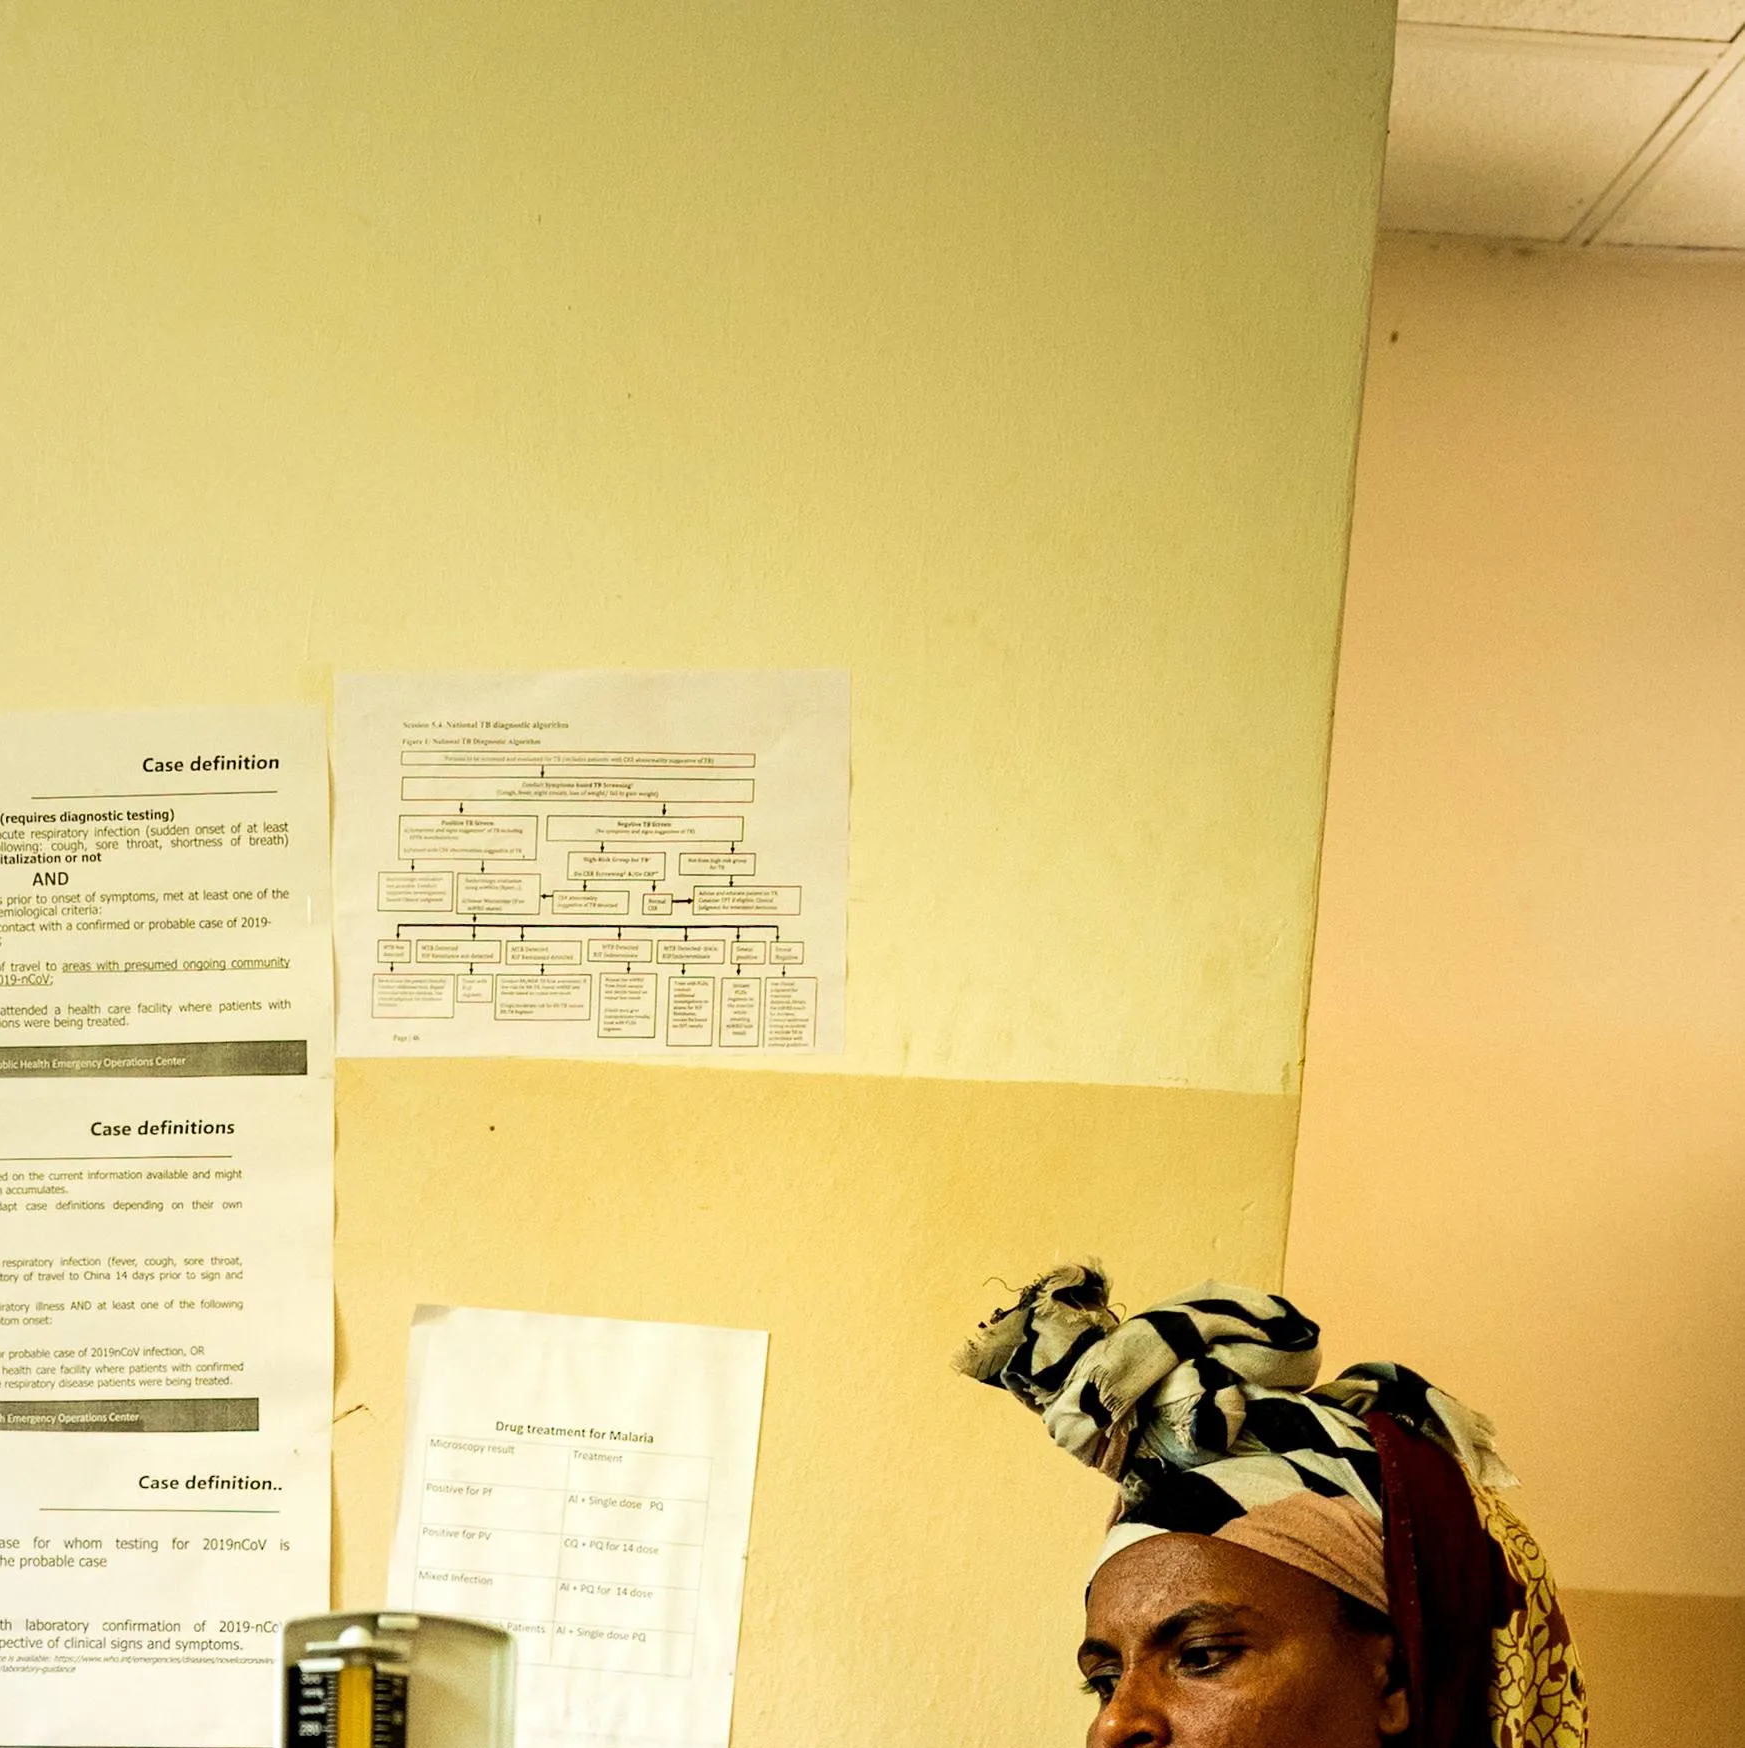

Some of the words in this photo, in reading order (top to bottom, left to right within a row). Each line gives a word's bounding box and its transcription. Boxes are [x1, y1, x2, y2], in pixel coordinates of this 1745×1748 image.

[142, 757, 184, 772] Case
[189, 755, 279, 771] definition
[59, 810, 123, 824] diagnostic
[64, 851, 78, 863] or
[81, 852, 102, 862] not
[32, 871, 69, 886] AND
[90, 1121, 131, 1136] Case
[137, 1119, 235, 1135] definitions
[495, 1420, 524, 1435] Drug
[527, 1425, 585, 1437] treatment
[589, 1427, 607, 1439] for
[609, 1430, 654, 1443] Malaria
[429, 1438, 486, 1453] Microscopy
[487, 1445, 515, 1454] result
[573, 1450, 623, 1463] Treatment
[138, 1475, 179, 1489] Case
[425, 1482, 464, 1495] Positive
[465, 1485, 480, 1496] for
[33, 1535, 51, 1549] for
[63, 1537, 103, 1549] whom
[115, 1538, 159, 1552] testing
[171, 1537, 190, 1550] for
[279, 1539, 290, 1551] is
